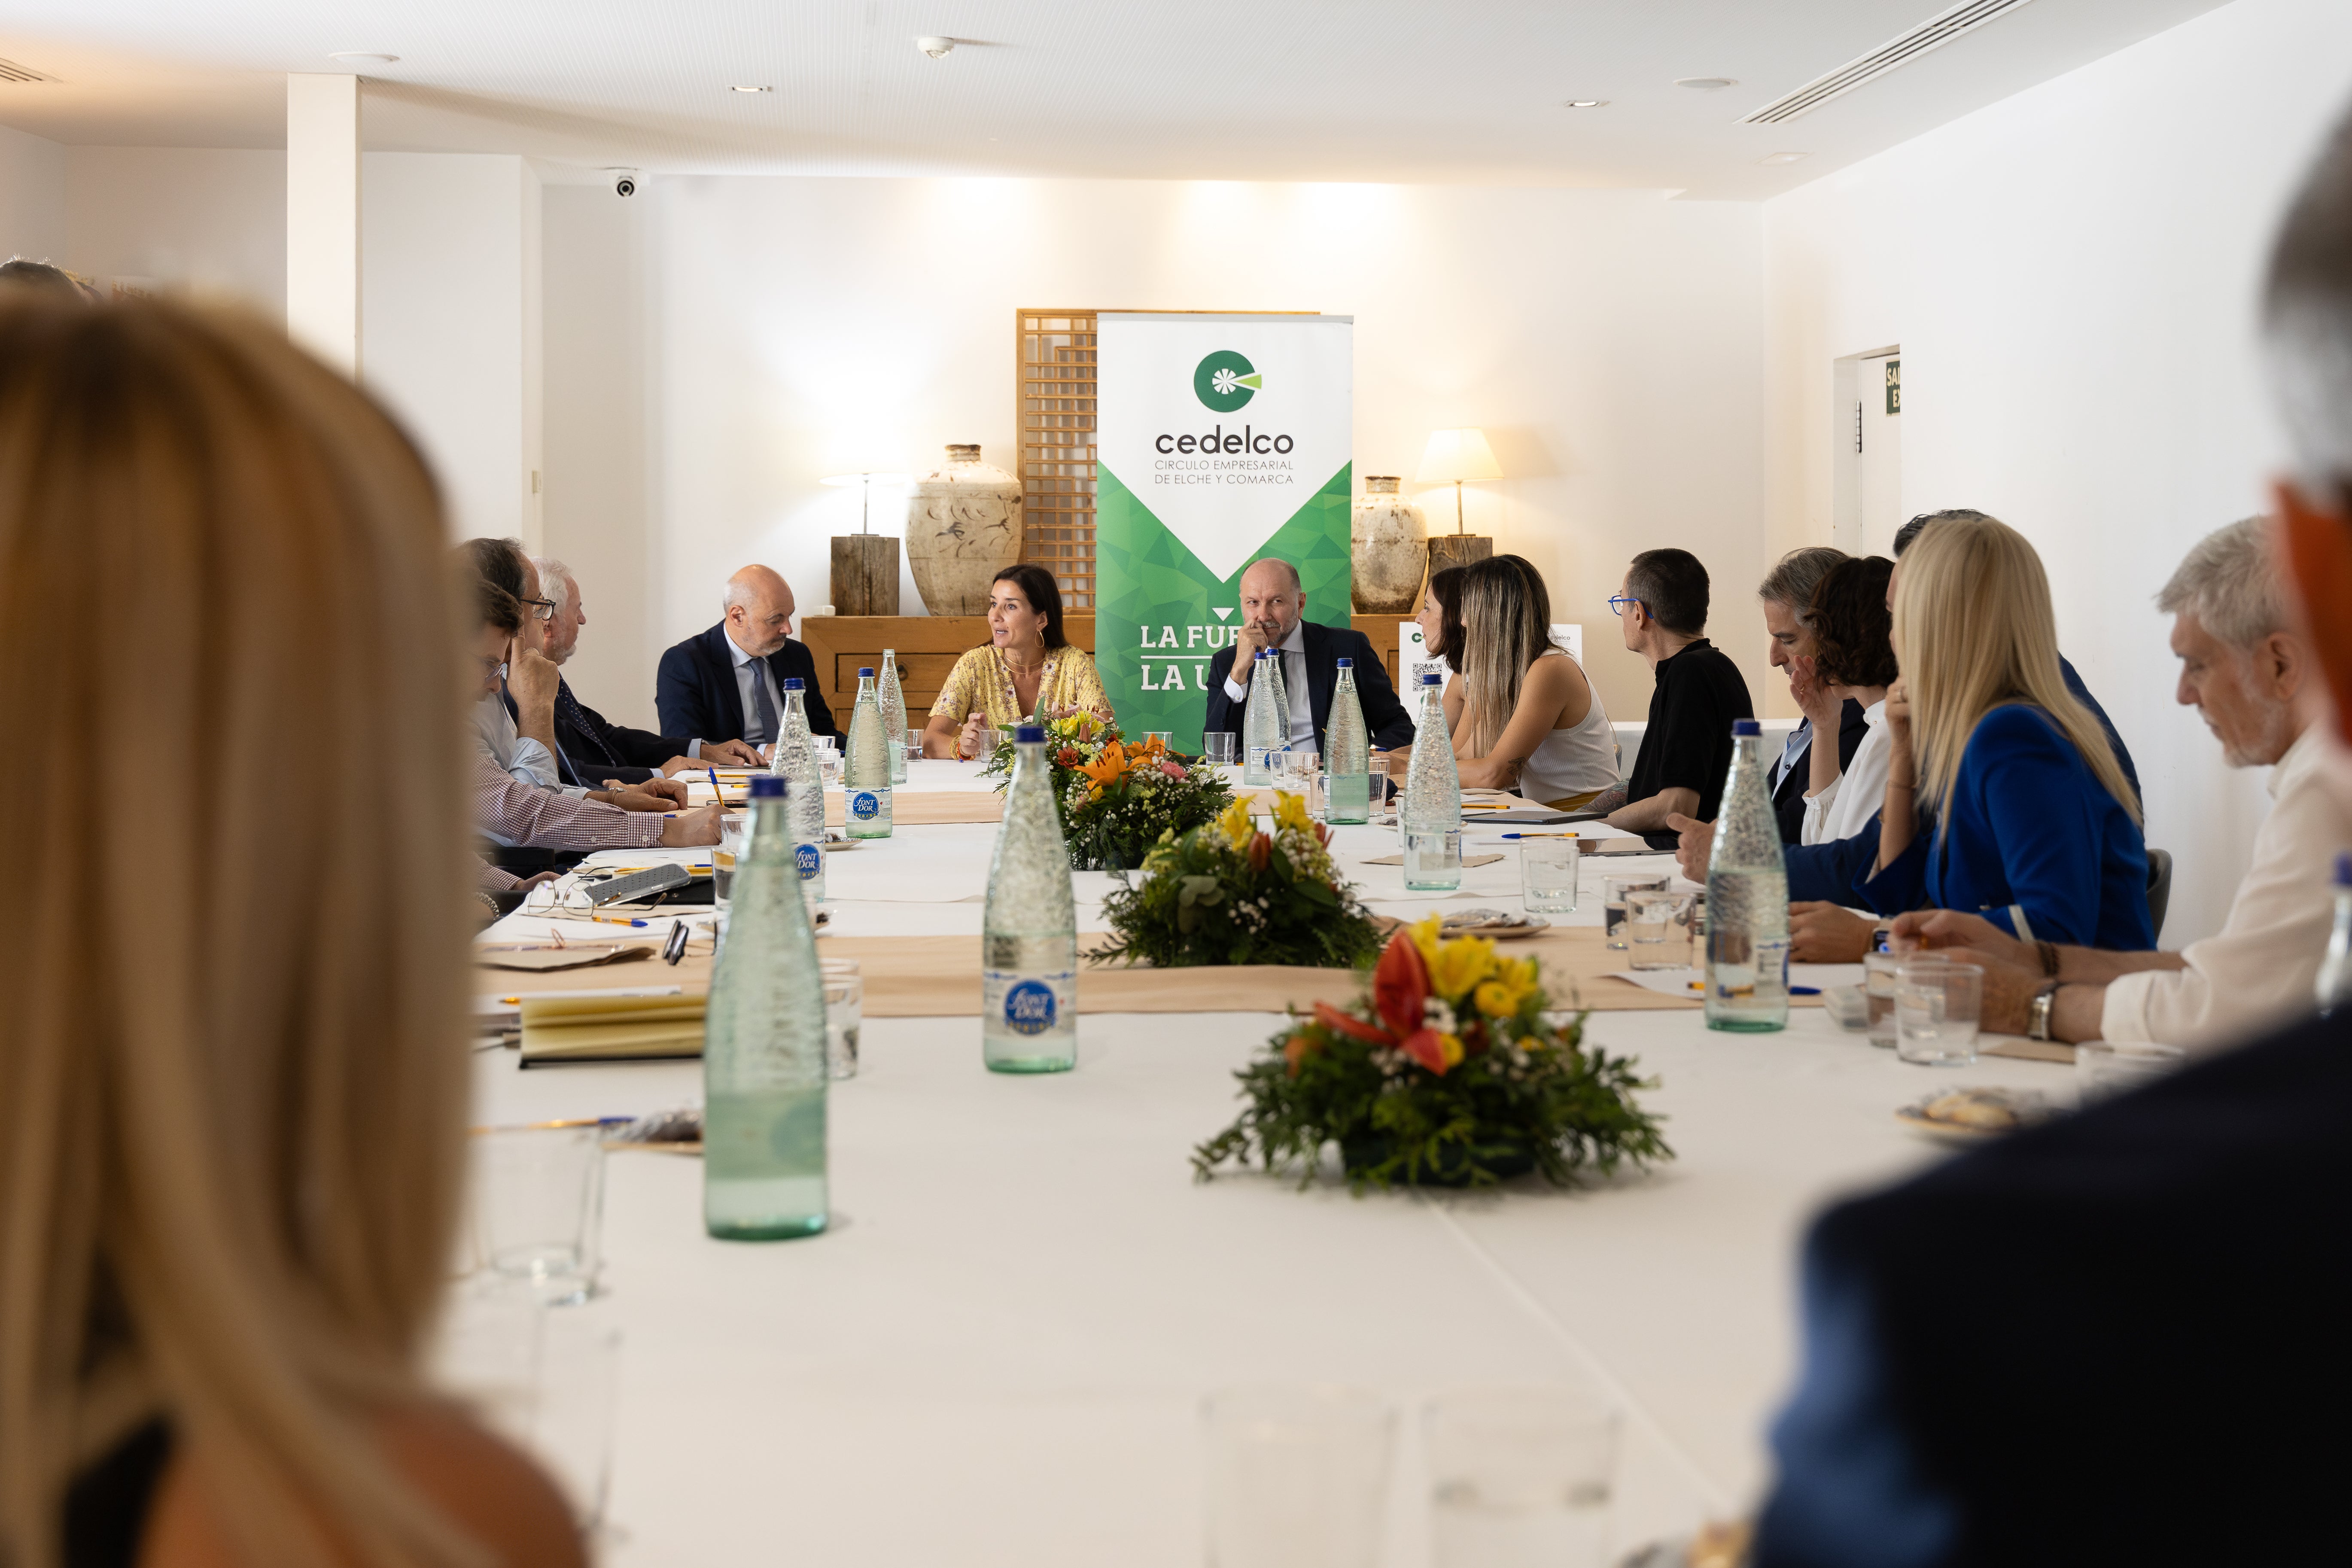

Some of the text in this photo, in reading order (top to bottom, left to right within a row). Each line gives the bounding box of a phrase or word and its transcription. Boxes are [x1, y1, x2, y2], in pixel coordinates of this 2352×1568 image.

[1155, 424, 1293, 454] cedelco
[1155, 460, 1293, 470] CIRCULO EMPRESARIAL
[1155, 474, 1293, 484] DE ELCHE Y COMARCA
[1141, 626, 1179, 648] LA
[1141, 665, 1185, 690] LA
